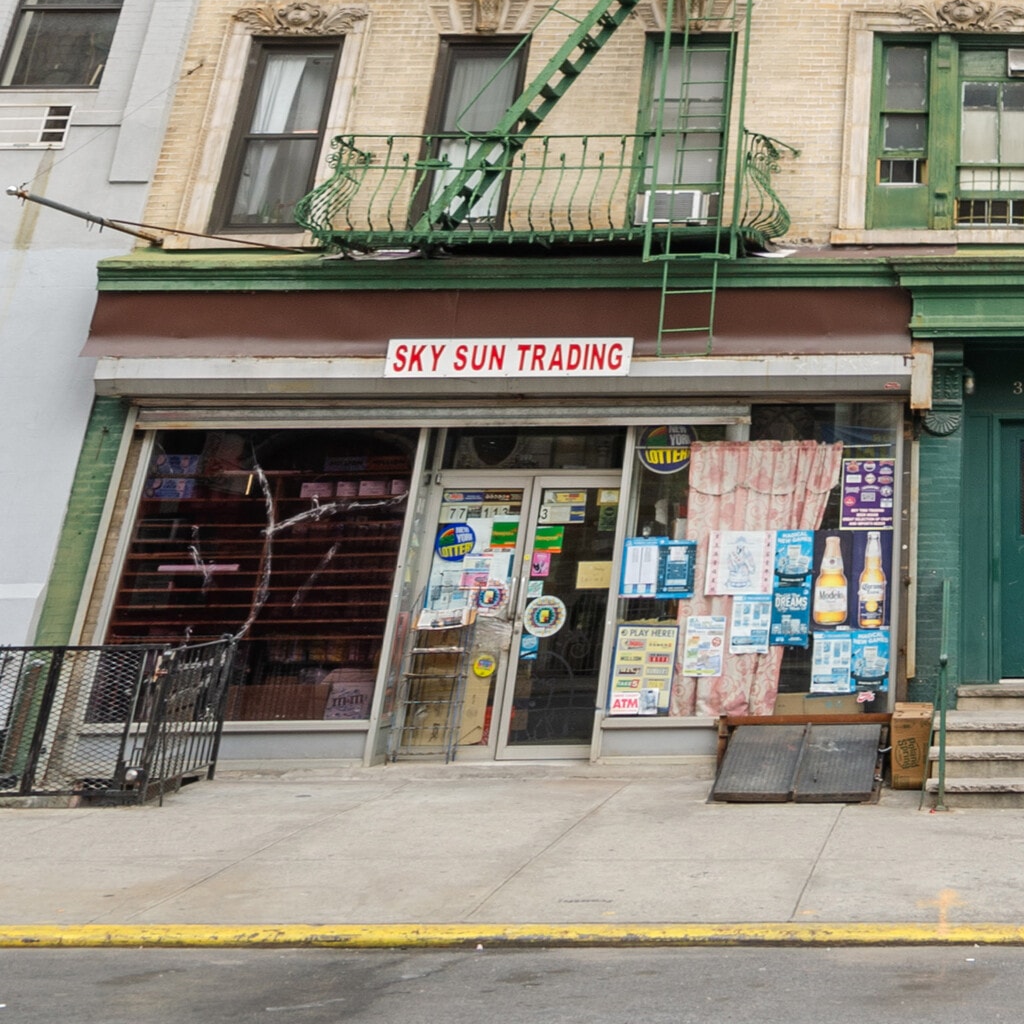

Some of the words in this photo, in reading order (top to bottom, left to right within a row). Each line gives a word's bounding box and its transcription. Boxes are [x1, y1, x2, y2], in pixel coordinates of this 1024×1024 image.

[393, 344, 446, 372] SKY
[453, 344, 506, 371] SUN
[517, 343, 623, 371] TRADING
[775, 596, 808, 609] DREAMS
[651, 629, 675, 637] HERE!
[612, 698, 639, 708] ATM
